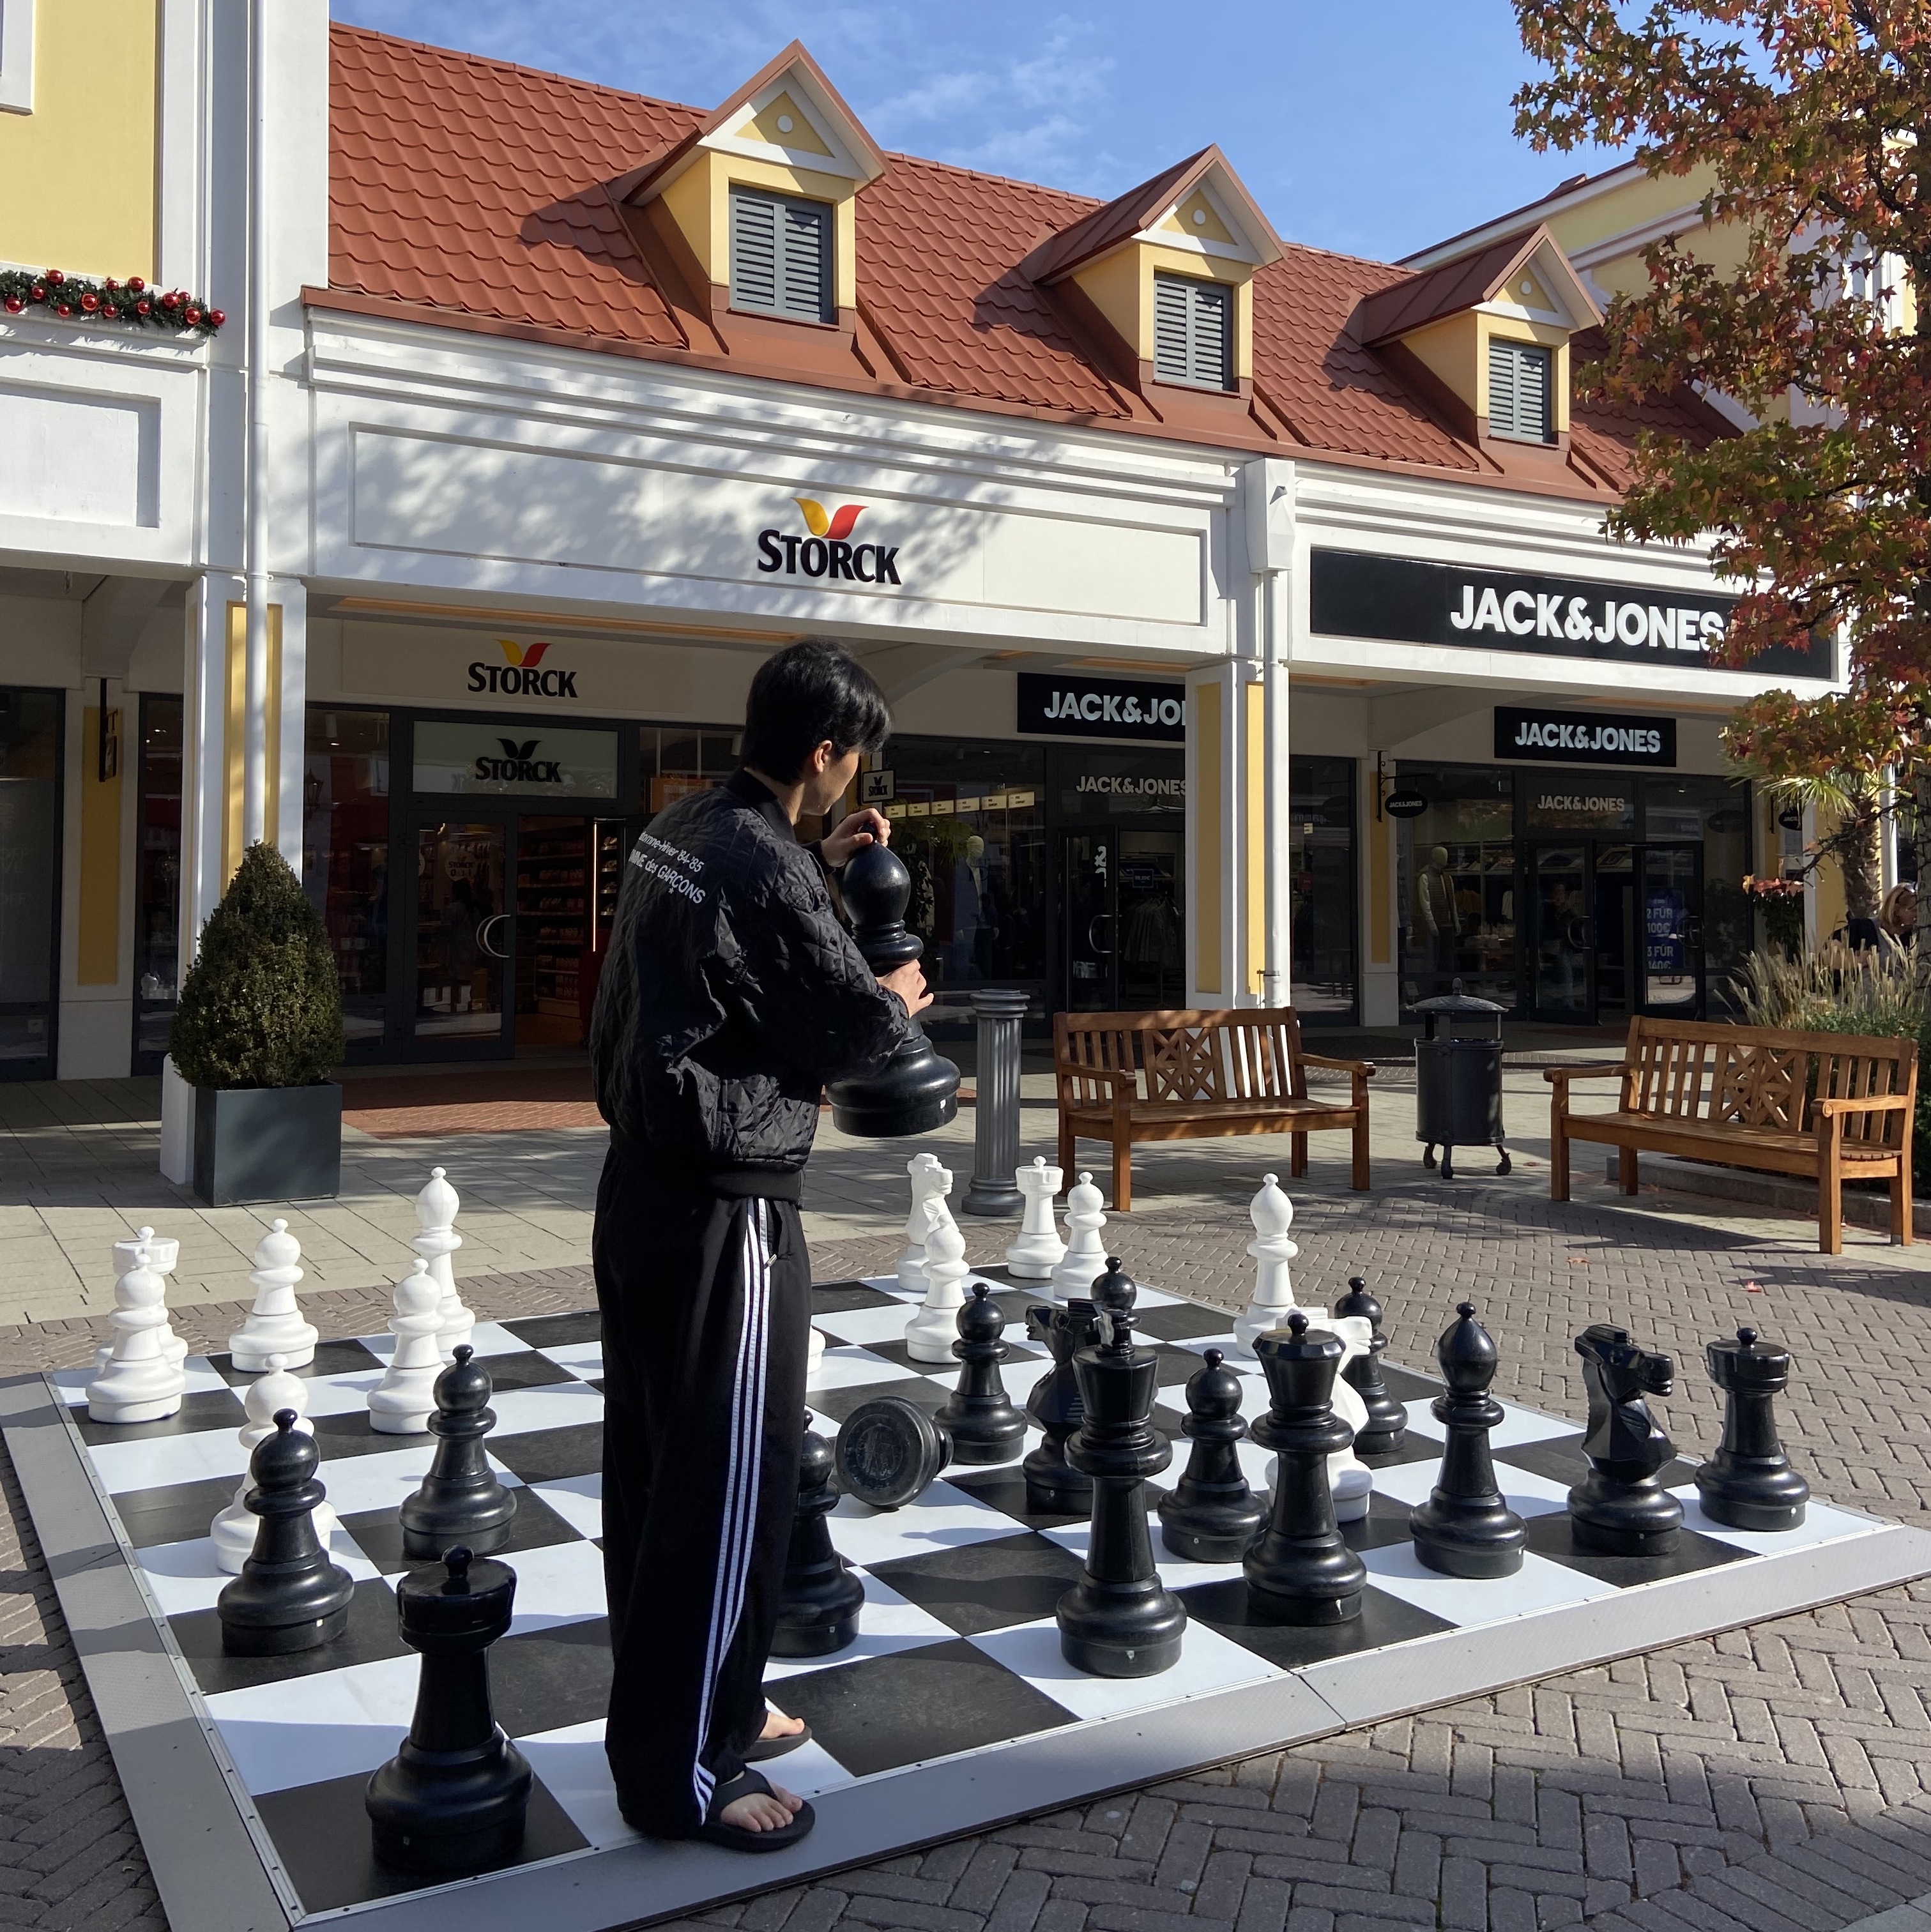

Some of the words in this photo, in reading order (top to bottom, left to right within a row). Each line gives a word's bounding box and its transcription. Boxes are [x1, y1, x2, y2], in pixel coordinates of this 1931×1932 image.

[758, 529, 901, 585] STORCK
[1450, 584, 1725, 652] JACK&JONES
[468, 662, 577, 698] STORCK
[1515, 722, 1661, 753] JACK&JONES
[475, 756, 562, 783] STORCK
[1389, 800, 1423, 809] JACK&JONES
[1537, 795, 1625, 812] JACK&JONES
[645, 858, 659, 874] des
[1646, 908, 1652, 919] 2
[1647, 922, 1670, 934] 100€
[1647, 945, 1652, 957] 3
